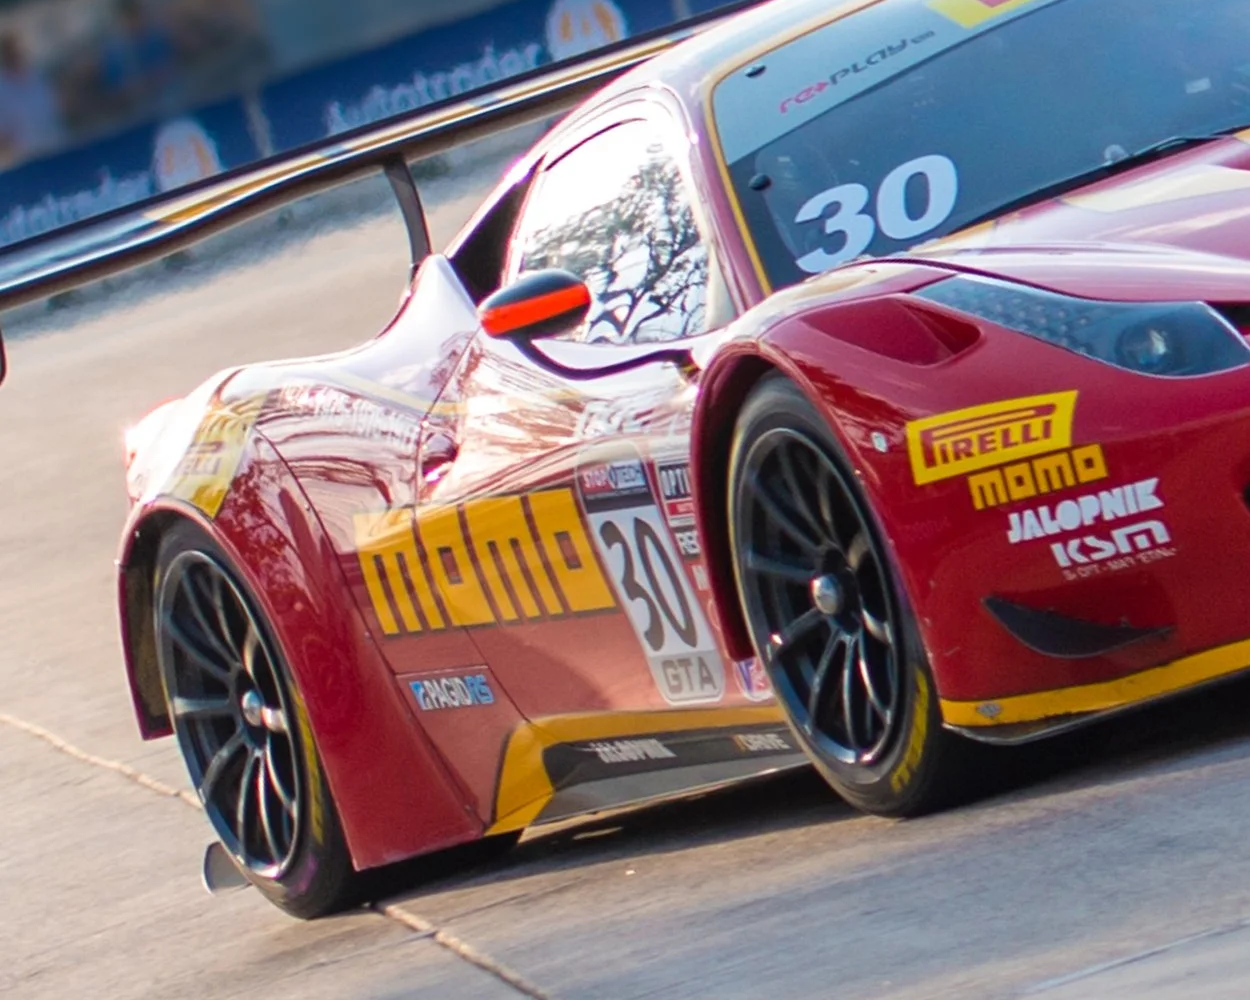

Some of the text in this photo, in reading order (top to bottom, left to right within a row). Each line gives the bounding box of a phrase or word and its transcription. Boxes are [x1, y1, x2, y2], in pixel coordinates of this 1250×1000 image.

[794, 154, 958, 274] 30
[919, 404, 1056, 469] PIRELLI
[1007, 477, 1164, 544] JALOPNIK
[599, 516, 697, 652] 30
[661, 657, 717, 694] GTA
